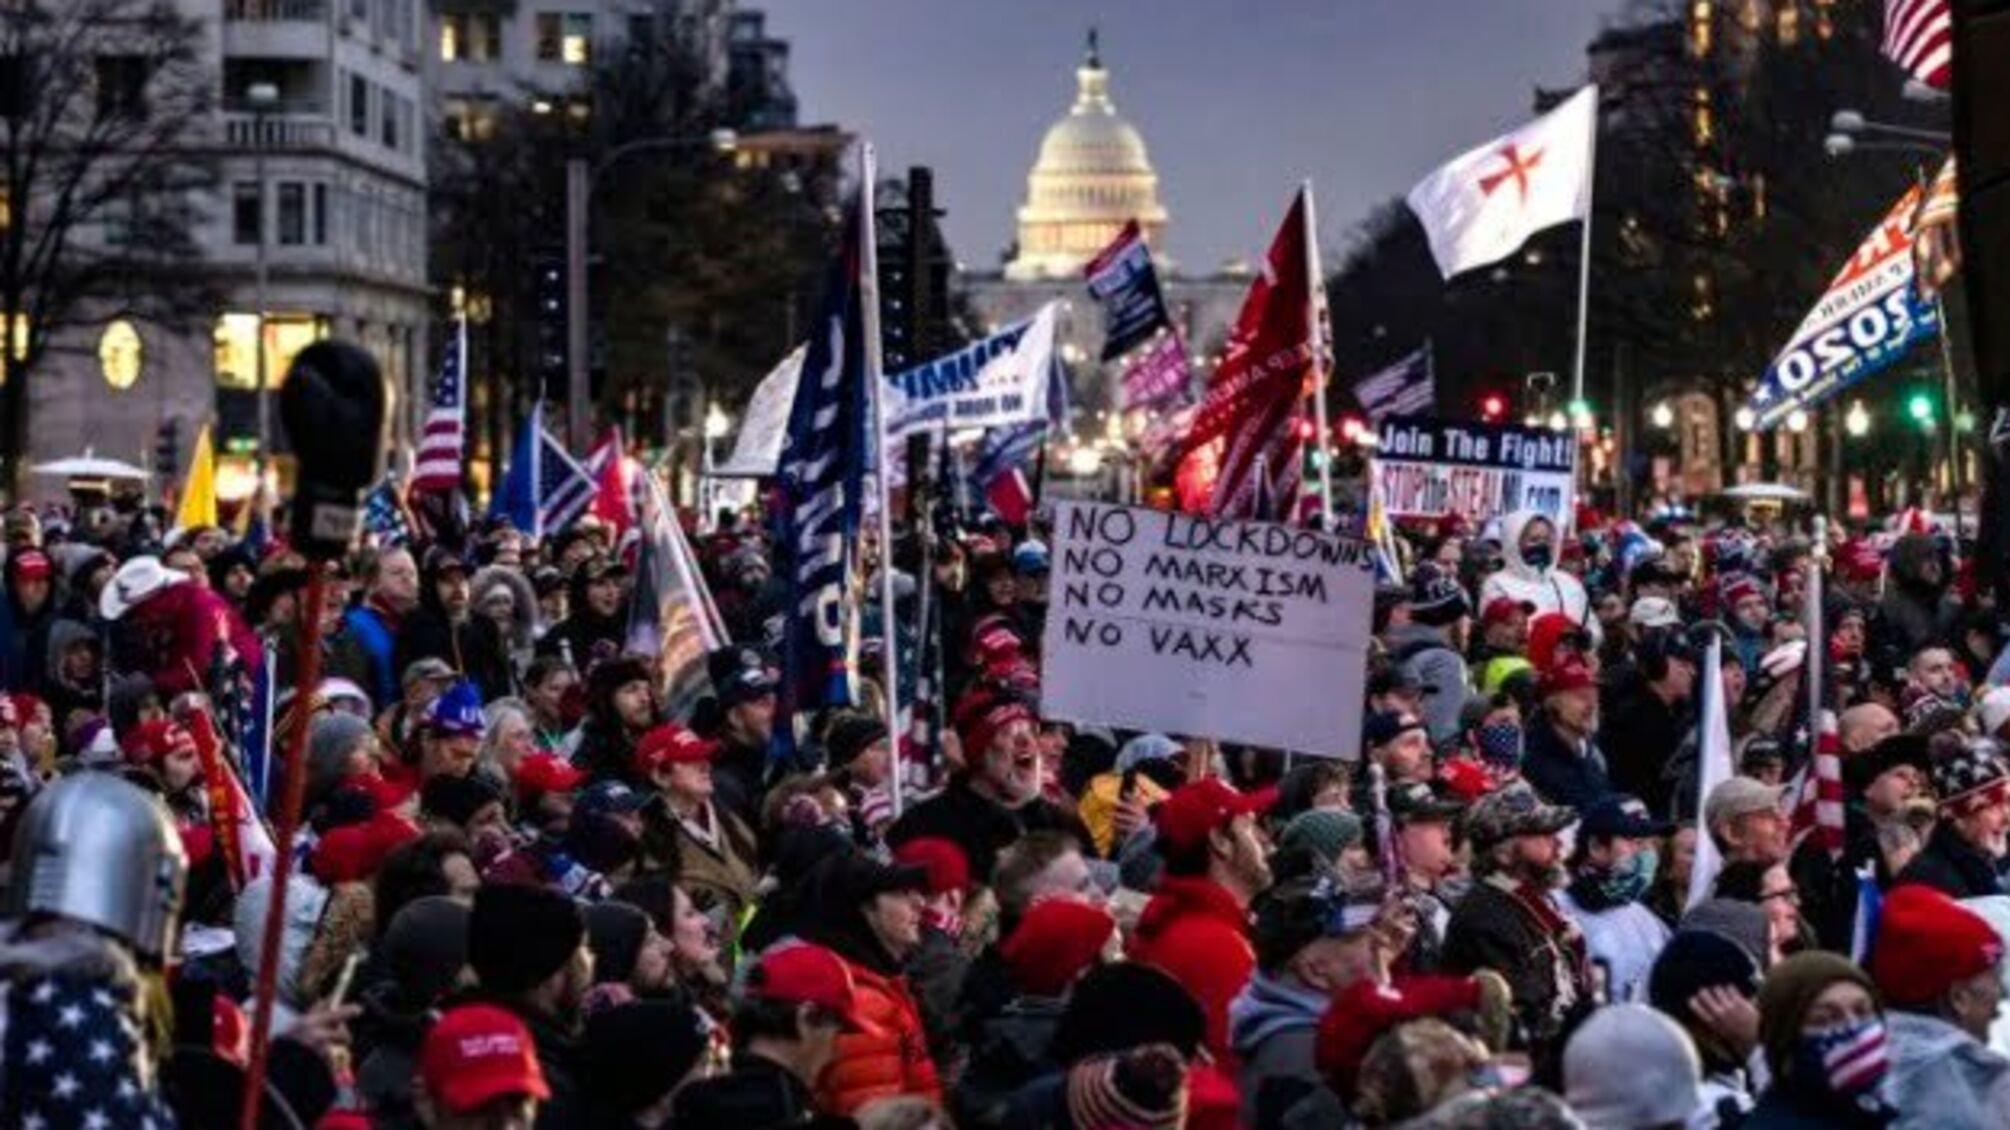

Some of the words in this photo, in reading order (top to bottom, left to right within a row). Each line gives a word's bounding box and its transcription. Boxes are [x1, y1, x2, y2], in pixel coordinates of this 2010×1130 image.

[1379, 424, 1433, 455] Join
[1444, 429, 1490, 460] The
[1500, 433, 1572, 469] Fight!
[1069, 506, 1135, 545] NO
[1165, 513, 1376, 572] LOCKDOWNS
[1064, 549, 1124, 577] NO
[1145, 555, 1328, 603] MARXISM
[1064, 583, 1125, 608] NO
[1142, 587, 1284, 626] MASKS
[1065, 618, 1123, 646] NO
[1150, 627, 1253, 668] VAXX
